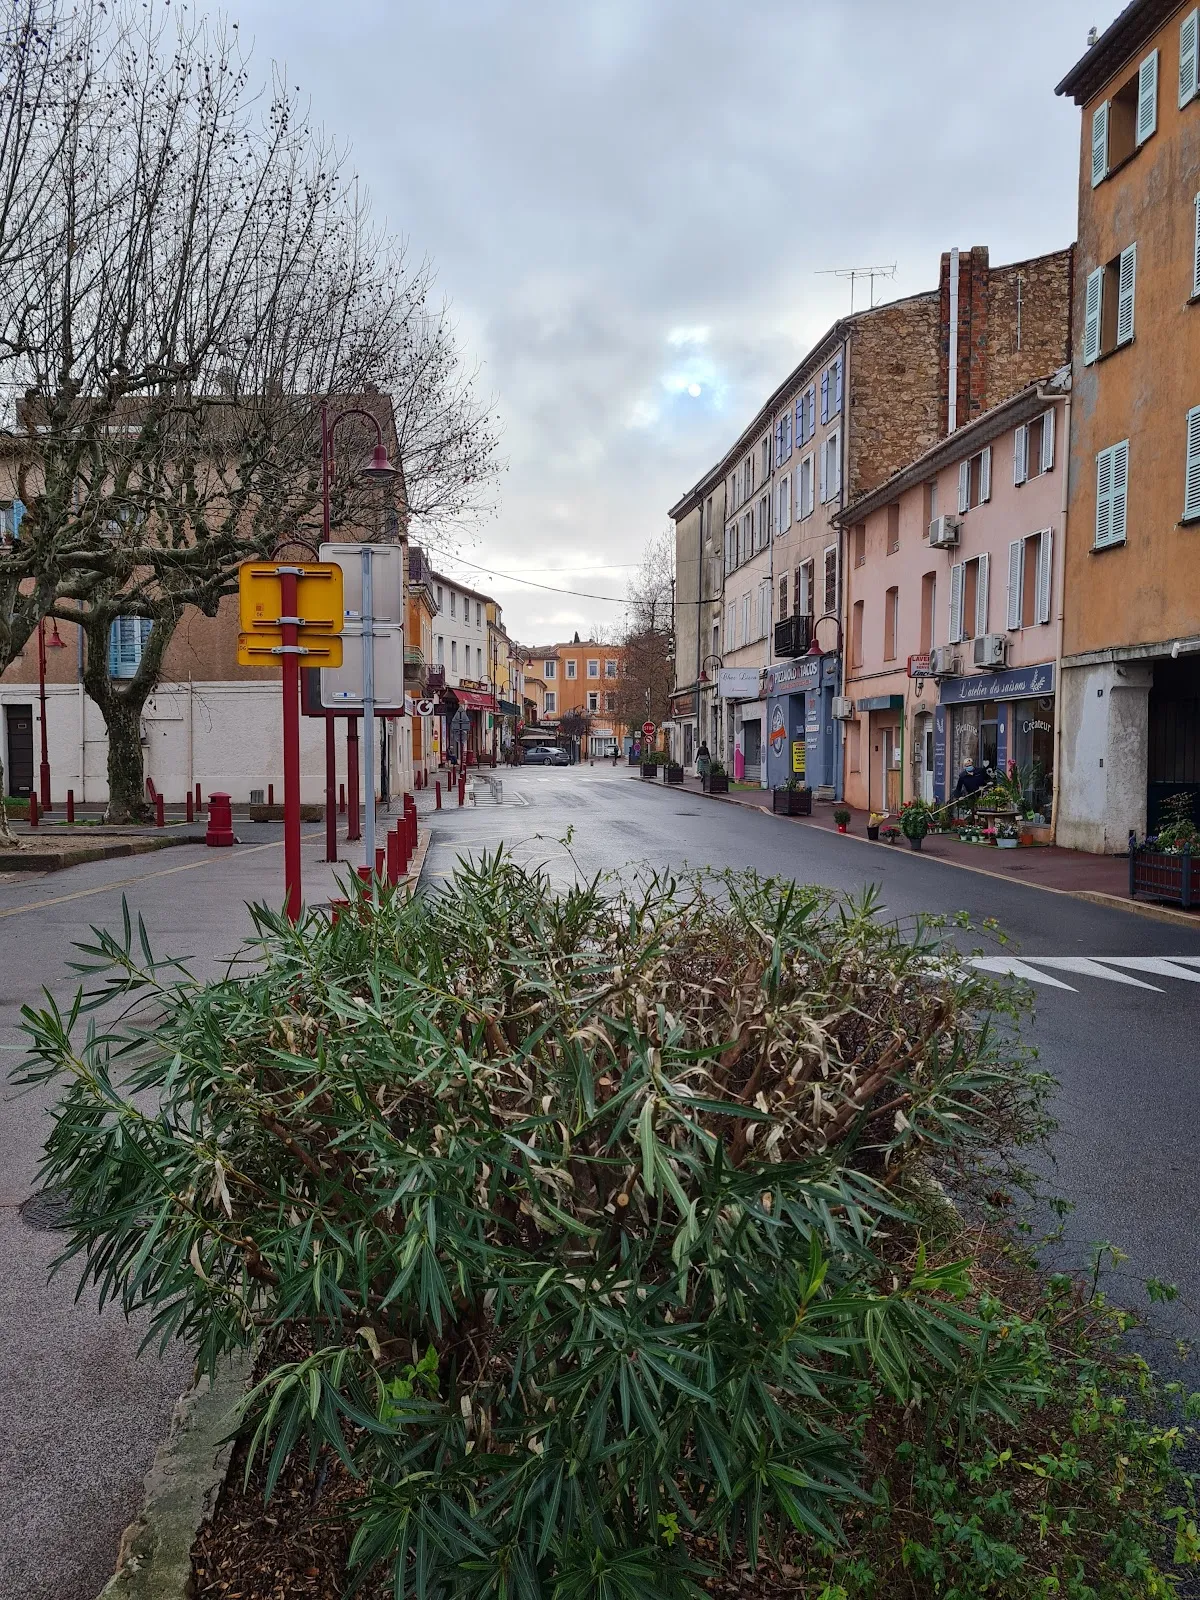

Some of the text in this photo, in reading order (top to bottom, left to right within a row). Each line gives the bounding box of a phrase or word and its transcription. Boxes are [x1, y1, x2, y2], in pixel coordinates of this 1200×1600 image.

[959, 679, 1026, 699] L'atelier des saisons
